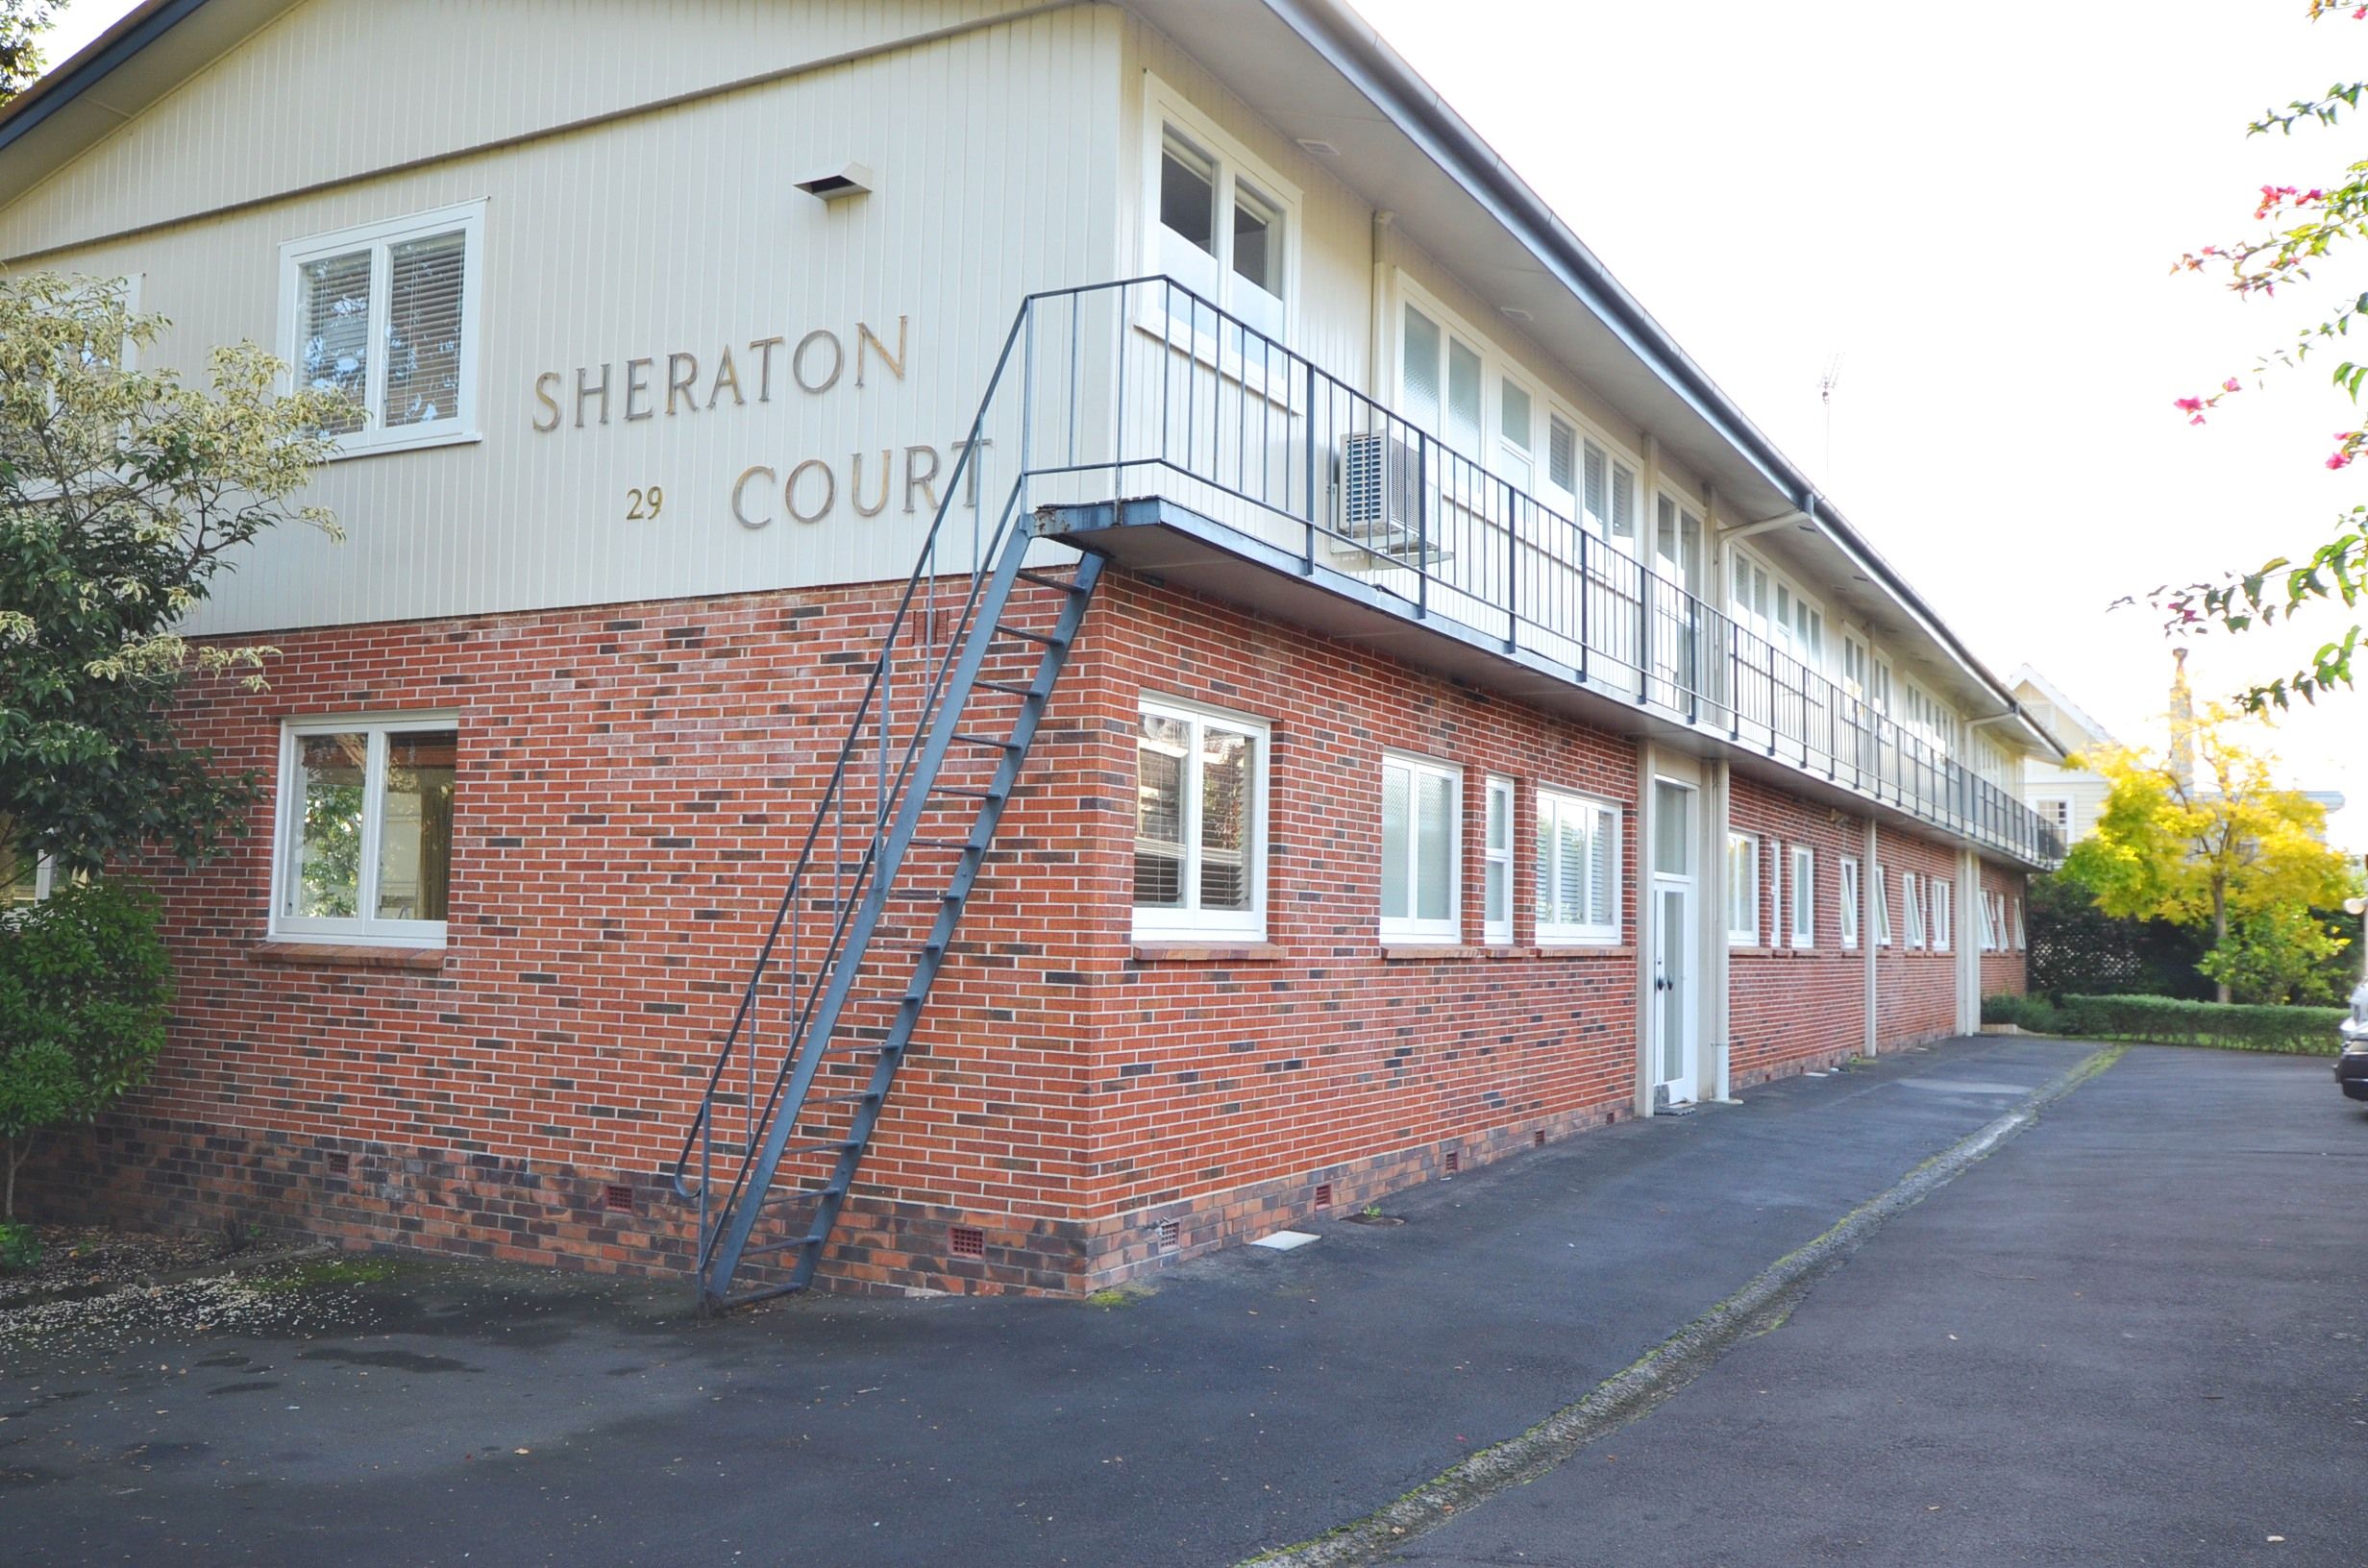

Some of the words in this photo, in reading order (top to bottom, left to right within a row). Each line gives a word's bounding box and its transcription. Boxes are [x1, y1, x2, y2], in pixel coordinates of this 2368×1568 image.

[532, 315, 908, 432] SHERATON
[626, 485, 663, 520] 29
[731, 438, 993, 529] COURT
